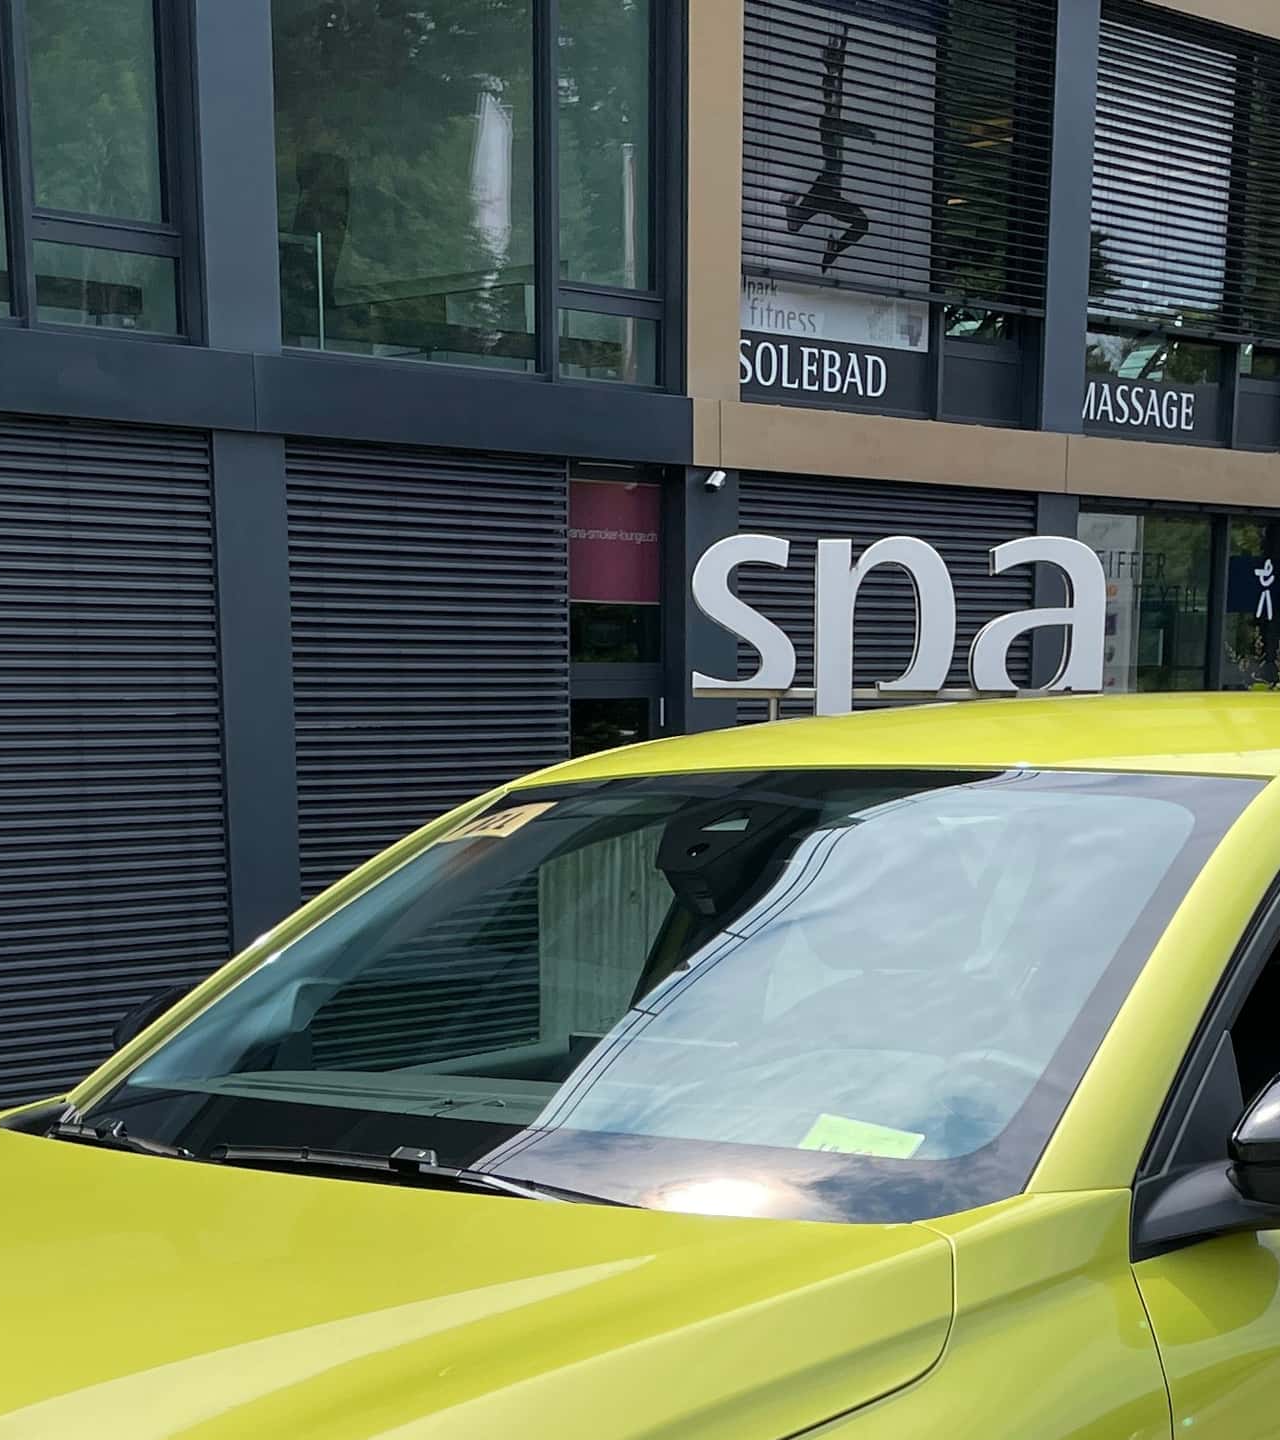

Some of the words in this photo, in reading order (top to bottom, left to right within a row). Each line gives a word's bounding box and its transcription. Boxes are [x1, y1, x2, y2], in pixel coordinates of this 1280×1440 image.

[750, 297, 817, 333] fitness
[739, 338, 888, 398] SOLEBAD
[691, 533, 1108, 717] spa
